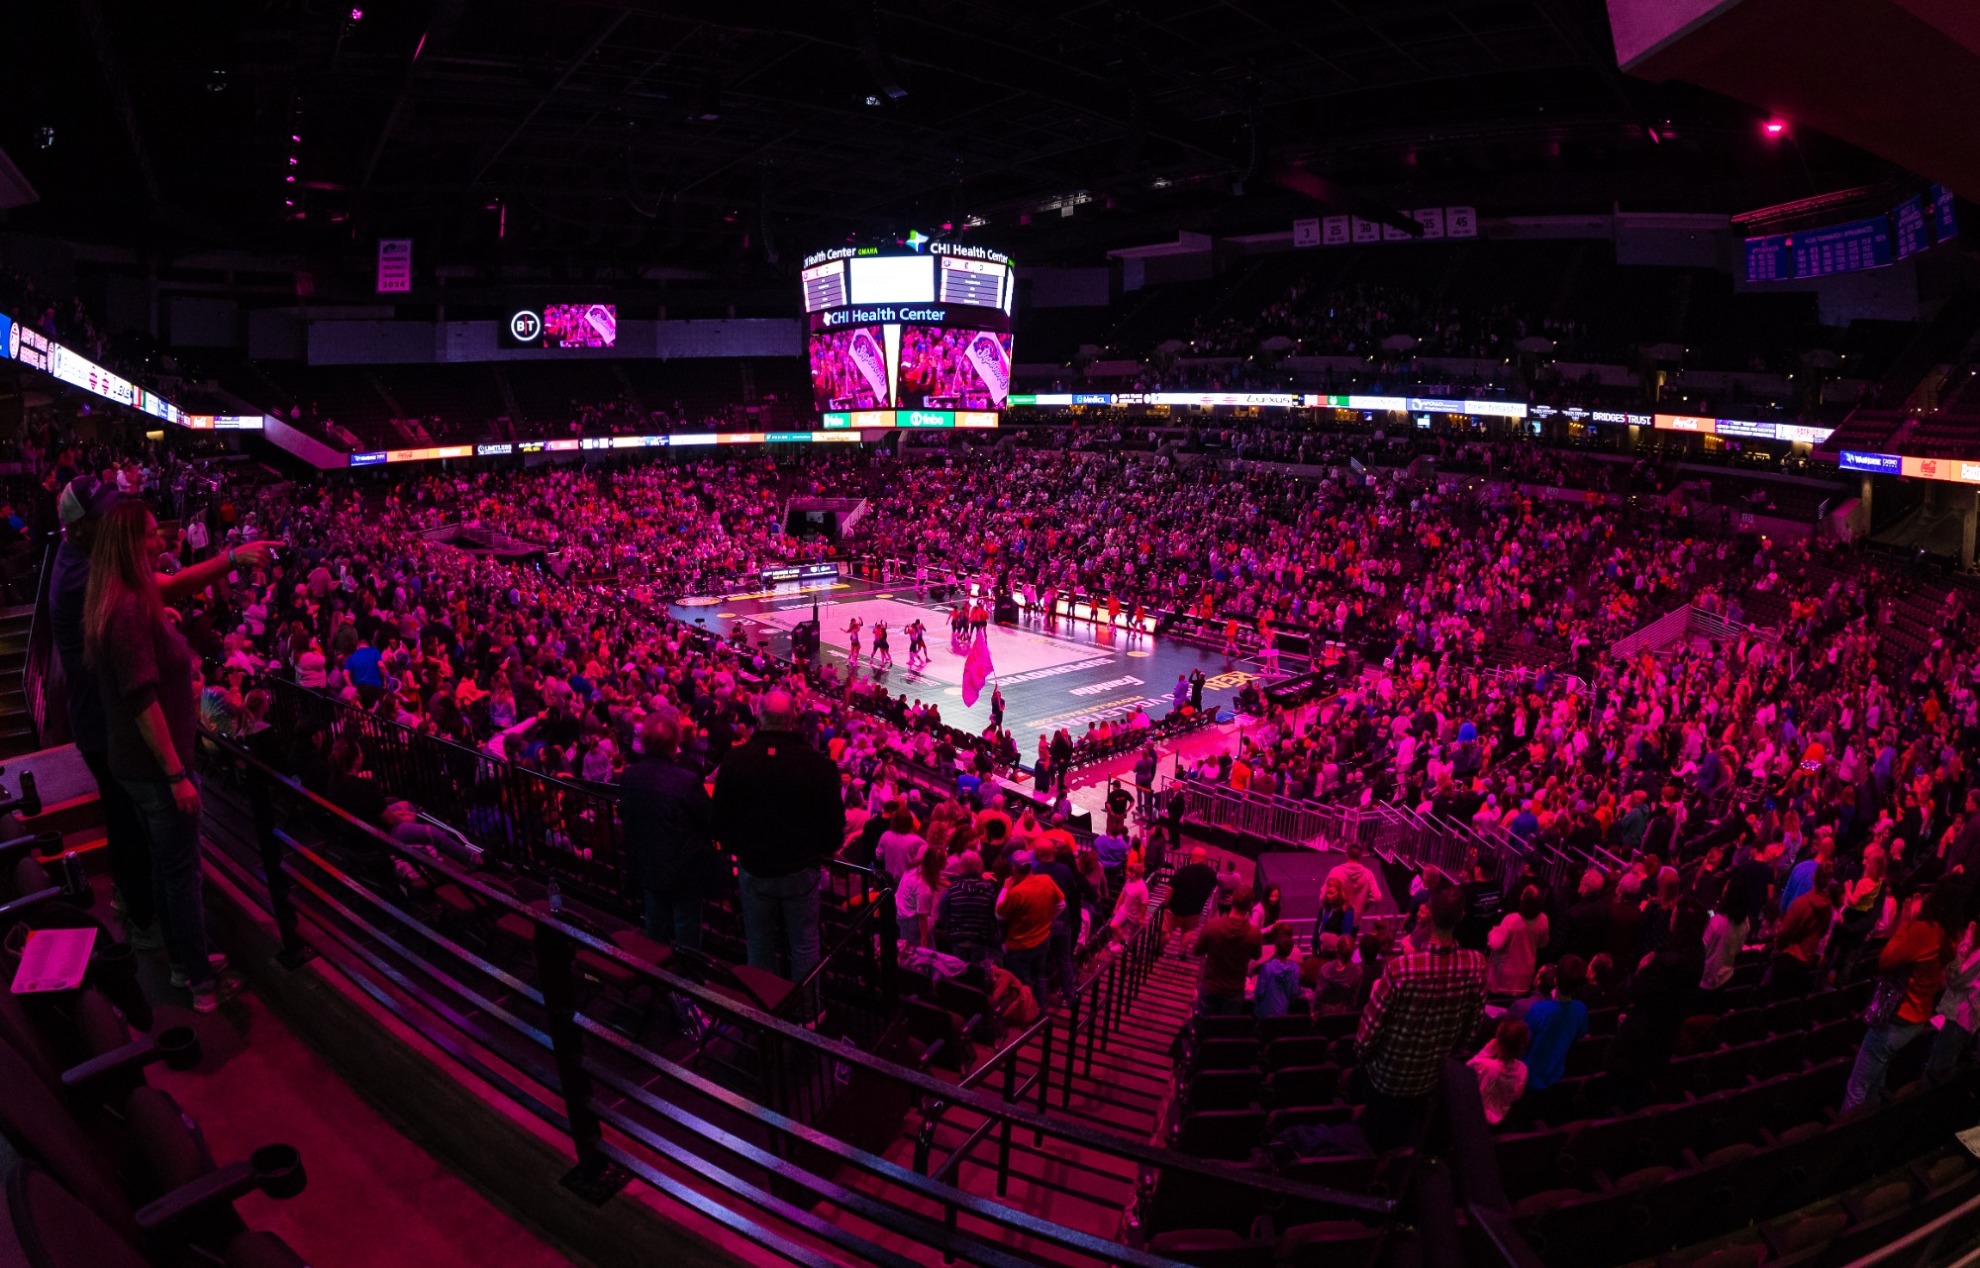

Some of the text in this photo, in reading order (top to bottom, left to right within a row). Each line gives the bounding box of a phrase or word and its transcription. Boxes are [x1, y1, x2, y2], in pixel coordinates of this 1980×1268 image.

[1423, 218, 1435, 229] 35
[1456, 217, 1468, 227] 45
[1304, 228, 1310, 238] 3
[1360, 223, 1371, 233] 30
[809, 250, 827, 266] Health
[827, 247, 857, 260] Center
[930, 242, 950, 255] CHI
[953, 244, 986, 259] Health
[987, 250, 1008, 264] Center
[831, 307, 945, 324] CHI Health Center
[1592, 411, 1625, 423] BRIDGES
